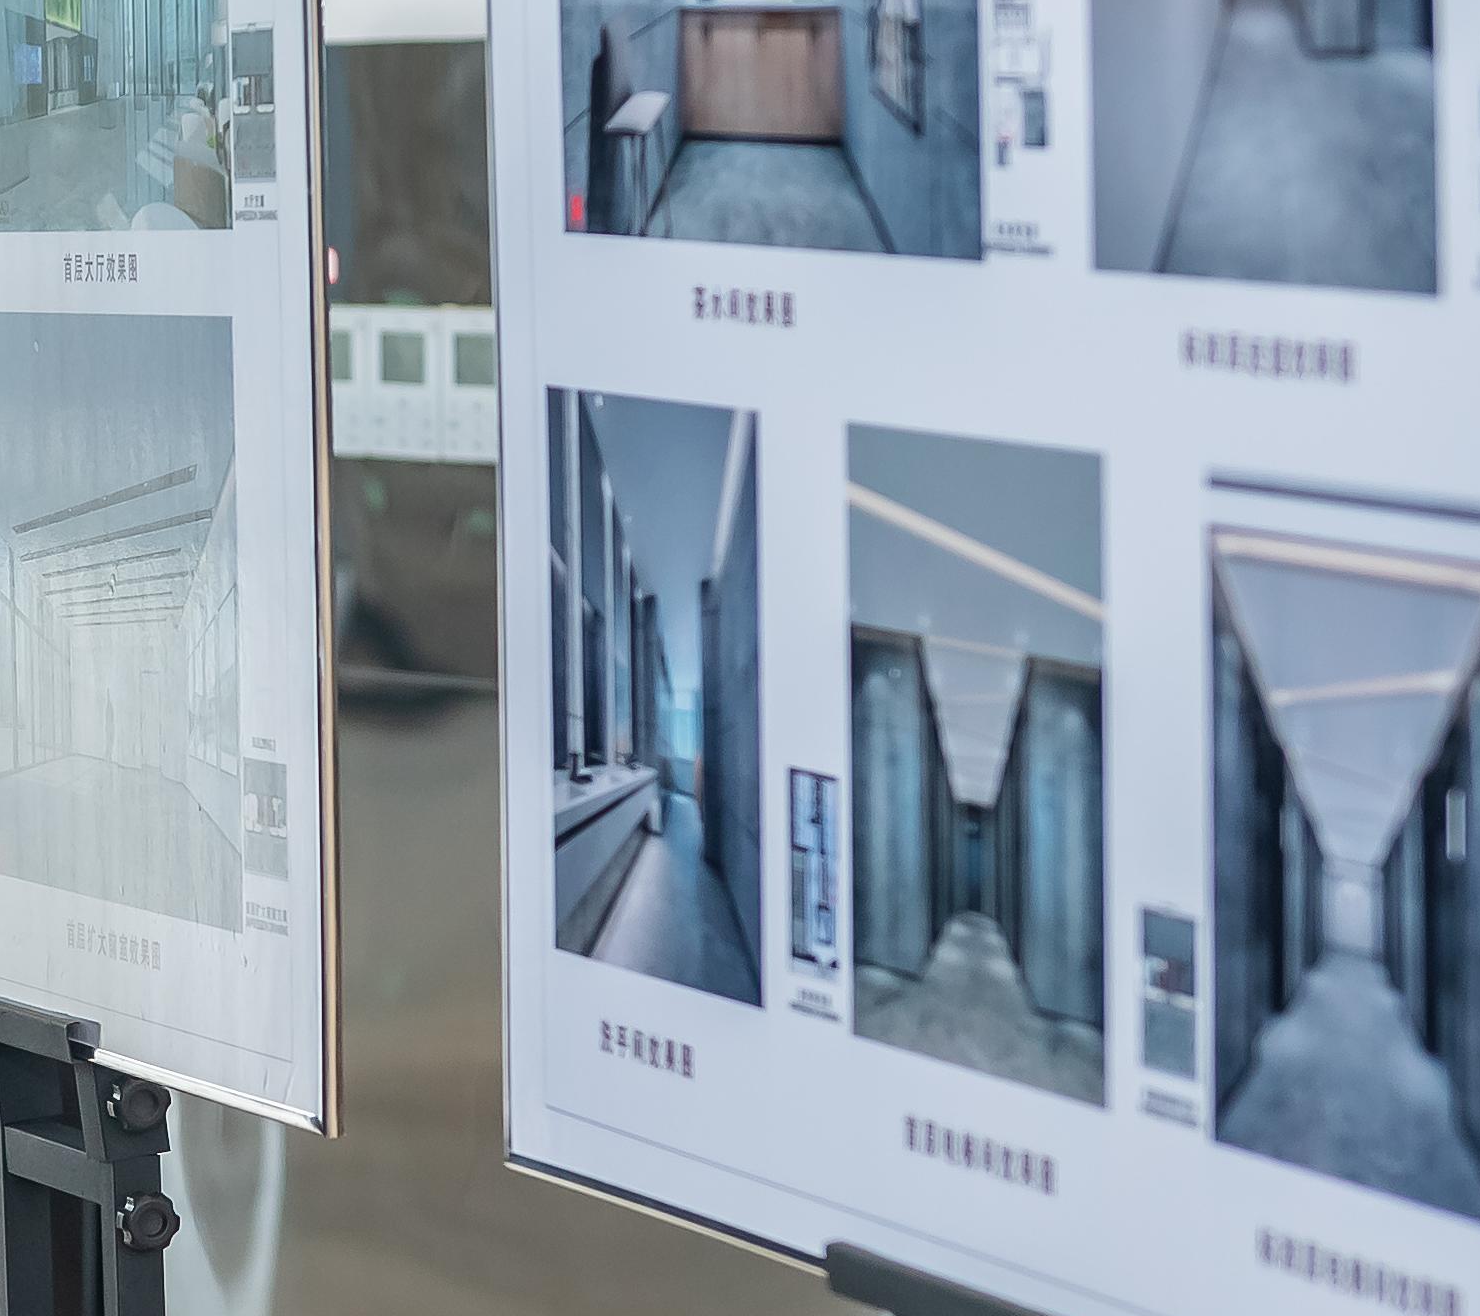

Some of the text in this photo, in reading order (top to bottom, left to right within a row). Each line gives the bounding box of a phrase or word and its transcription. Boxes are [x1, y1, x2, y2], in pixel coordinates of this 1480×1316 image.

[63, 252, 139, 284] 首层大厅效果图
